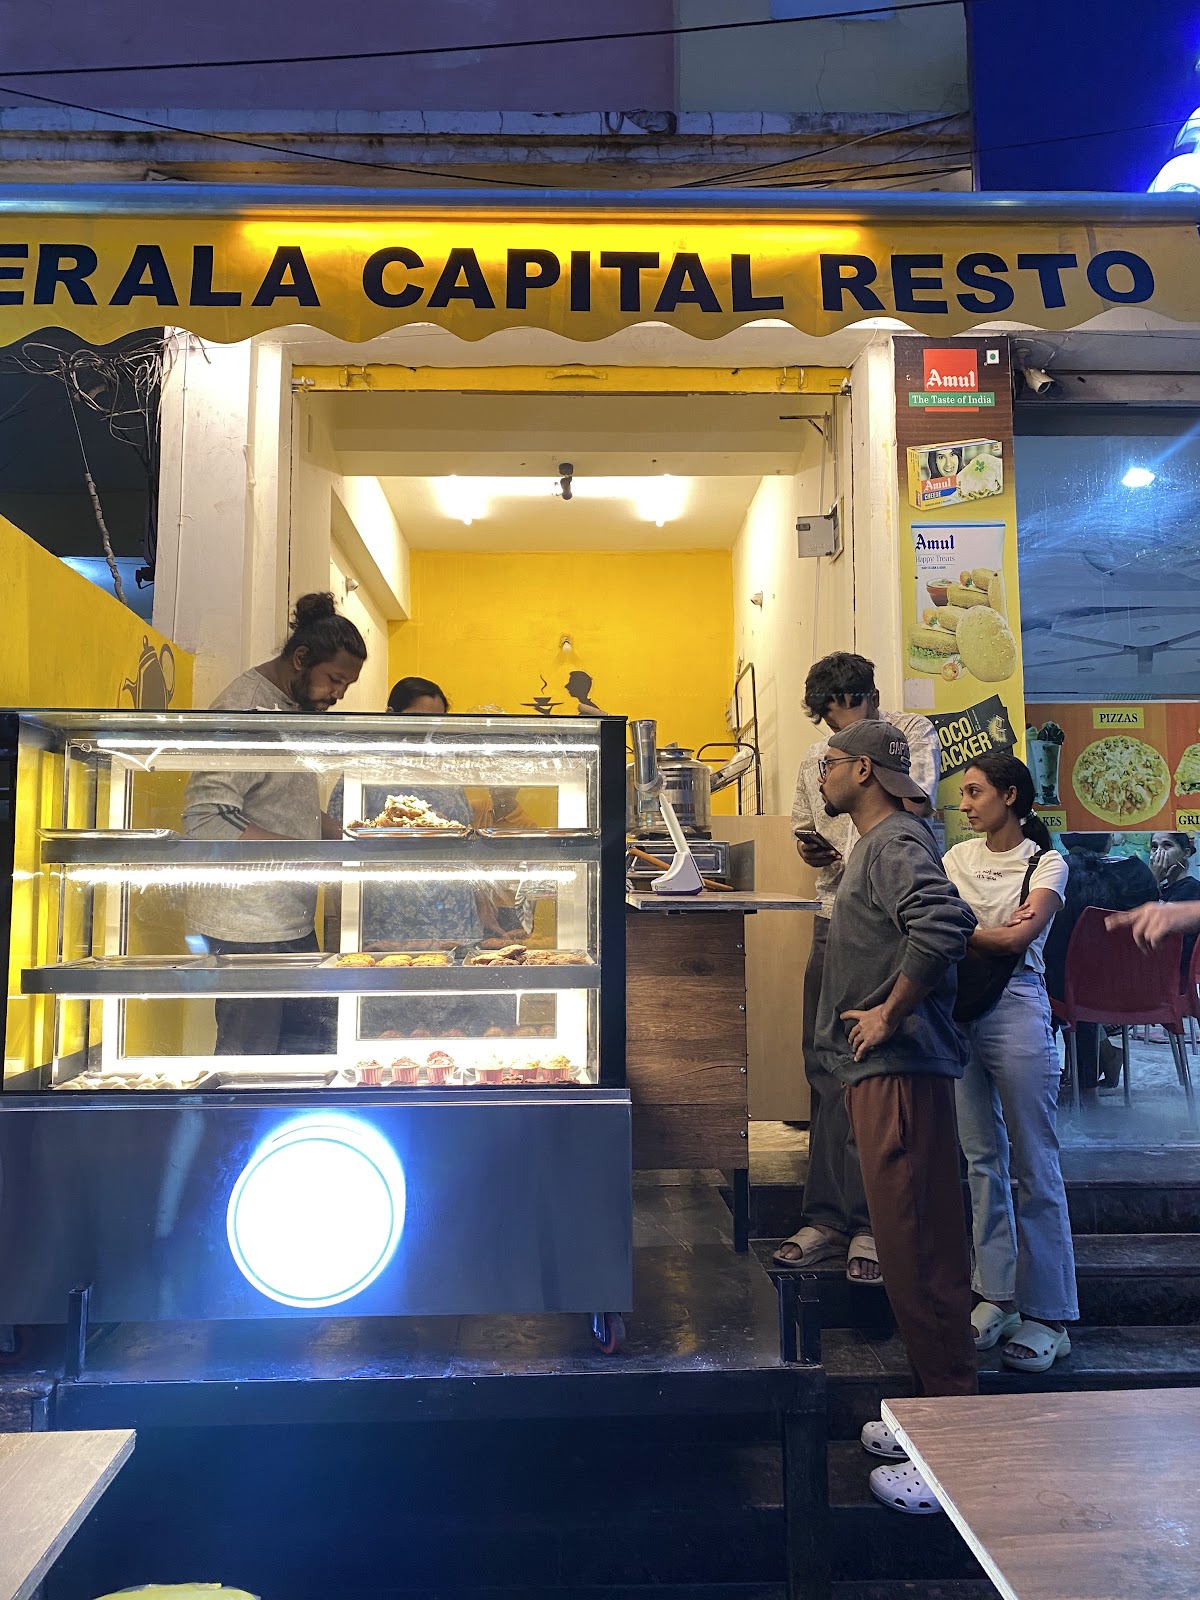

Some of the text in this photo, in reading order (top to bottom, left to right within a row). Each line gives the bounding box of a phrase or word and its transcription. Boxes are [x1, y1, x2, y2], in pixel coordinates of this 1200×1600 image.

[362, 246, 784, 313] CAPITAL
[819, 250, 1155, 315] RESTO
[926, 368, 976, 389] Amul
[912, 395, 992, 404] The Taste of India
[924, 478, 952, 492] Amul
[915, 533, 955, 552] Amul
[1099, 713, 1138, 723] PIZZAS
[938, 717, 973, 749] OCO
[940, 731, 993, 773] ACKER
[1043, 816, 1062, 826] KES
